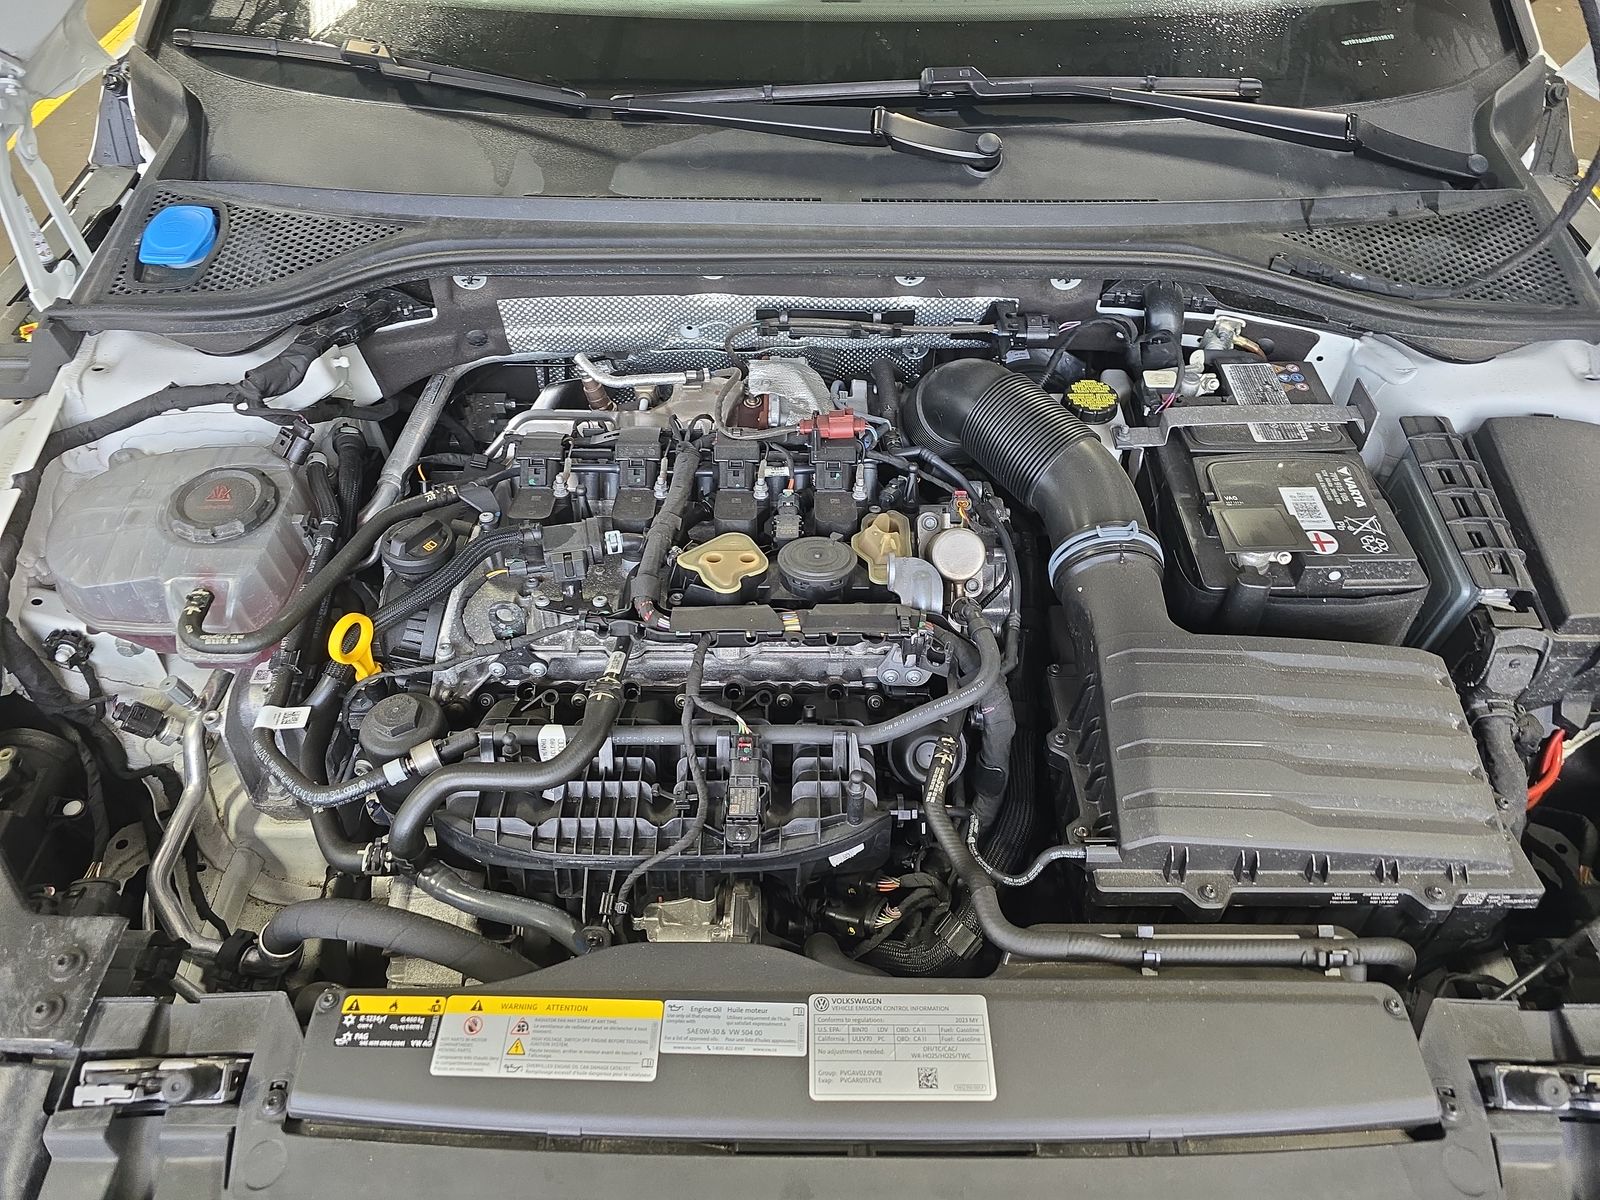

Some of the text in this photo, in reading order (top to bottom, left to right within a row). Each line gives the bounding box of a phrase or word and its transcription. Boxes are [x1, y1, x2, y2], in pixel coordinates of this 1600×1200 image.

[1344, 476, 1367, 507] VARTA
[1335, 521, 1346, 530] Pb
[359, 1015, 388, 1024] R-1234yf
